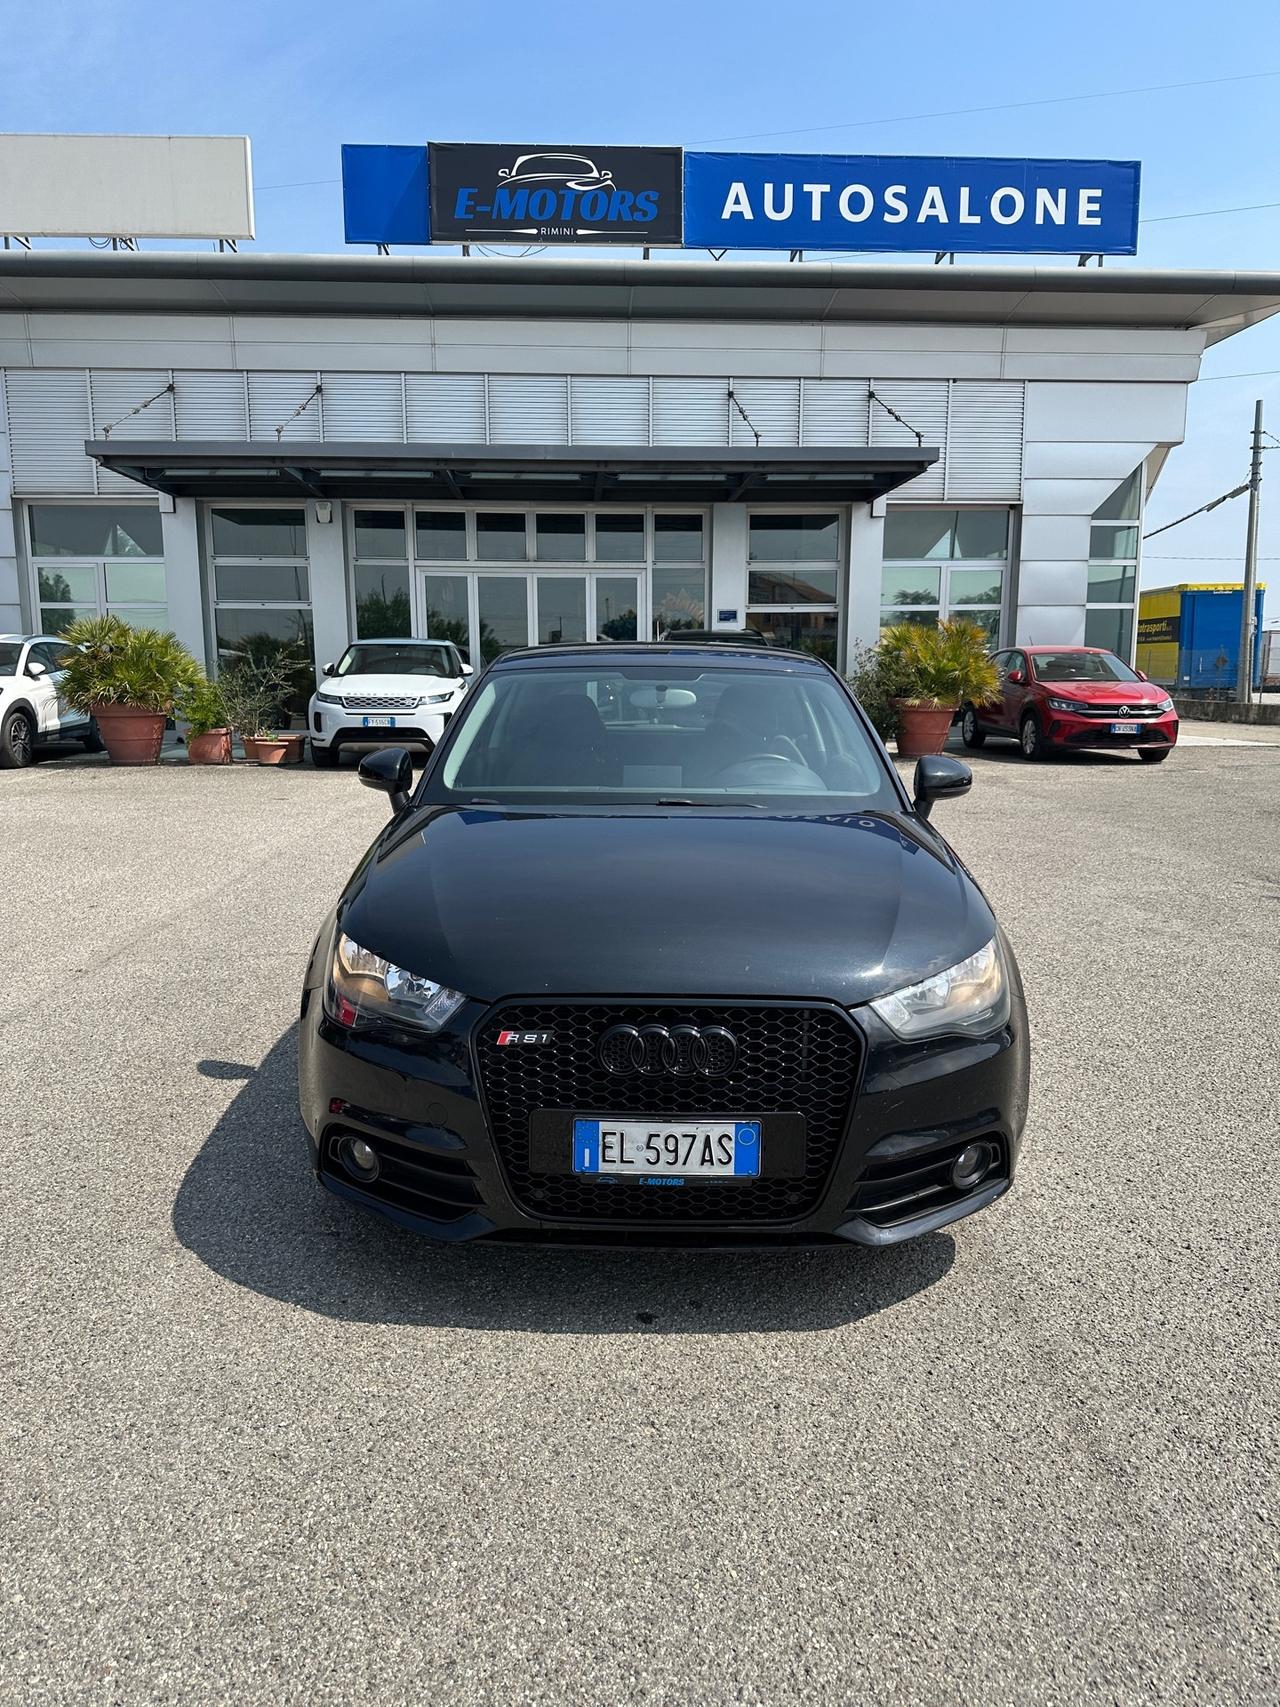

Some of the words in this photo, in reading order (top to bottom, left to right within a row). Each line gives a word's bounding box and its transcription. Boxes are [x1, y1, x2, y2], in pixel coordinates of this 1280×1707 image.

[454, 187, 661, 222] E-MOTORS
[721, 182, 1103, 226] AUTOSALONE
[540, 227, 574, 236] RIMINI
[497, 1031, 549, 1046] RS1
[601, 1131, 635, 1165] EL
[645, 1133, 733, 1167] 597AS
[638, 1177, 685, 1187] E-MOTORS
